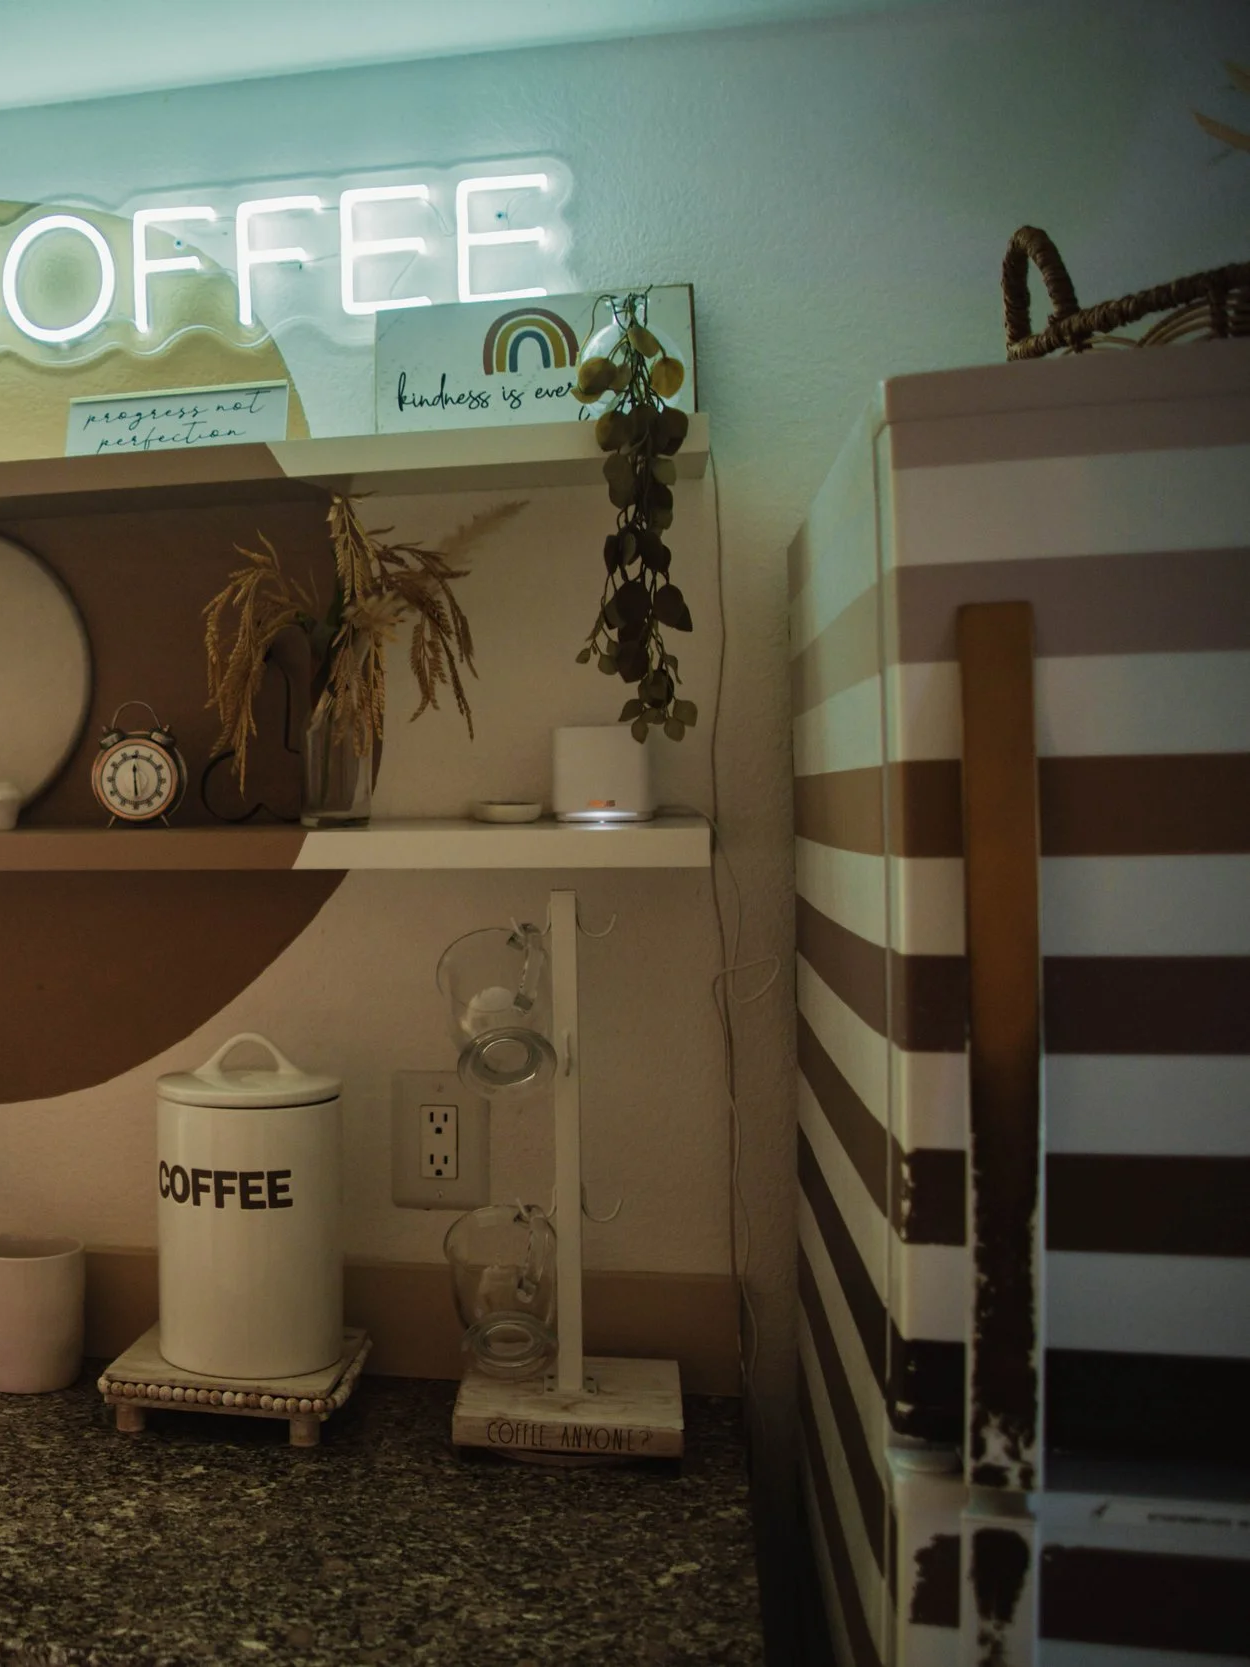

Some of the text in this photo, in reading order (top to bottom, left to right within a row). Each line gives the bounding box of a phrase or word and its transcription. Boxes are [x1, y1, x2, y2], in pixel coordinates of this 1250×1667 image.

[83, 389, 271, 431] progress not
[398, 371, 492, 412] kindness
[501, 385, 526, 410] is
[96, 420, 247, 454] perfection
[159, 1160, 293, 1209] COFFEE
[487, 1421, 654, 1451] COFFEE ANYONE?
